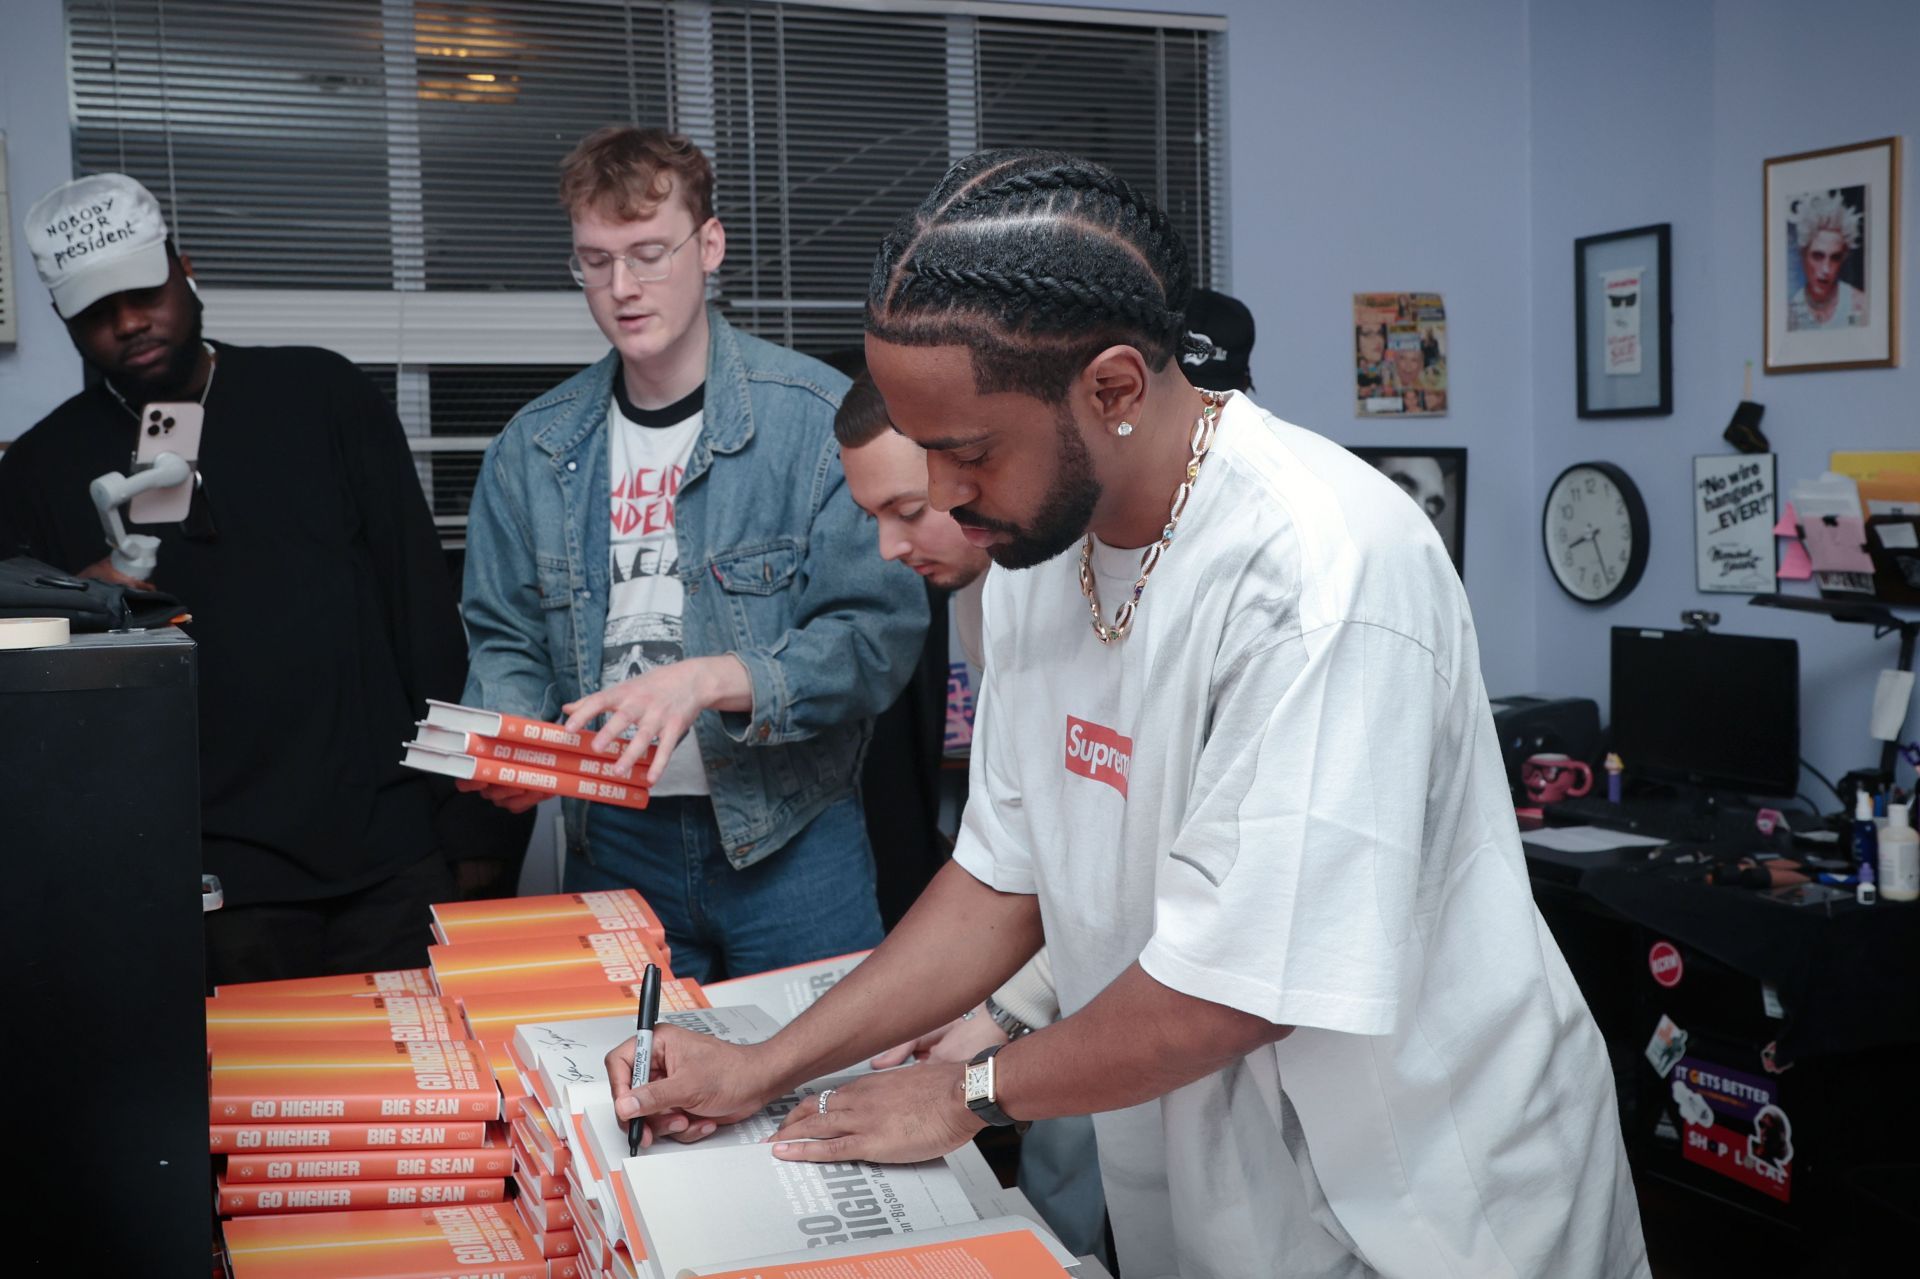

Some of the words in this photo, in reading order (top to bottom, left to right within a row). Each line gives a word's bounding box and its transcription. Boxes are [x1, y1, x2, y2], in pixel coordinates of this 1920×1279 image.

[46, 197, 113, 237] NOBODY
[66, 216, 110, 242] FOR
[54, 220, 136, 270] president
[1728, 463, 1760, 484] wire
[1703, 480, 1764, 513] hangers
[524, 724, 540, 739] GO
[541, 728, 581, 747] HIGHER
[605, 741, 619, 755] IG
[1067, 724, 1130, 781] Suprem
[494, 744, 511, 759] GO
[513, 748, 557, 767] HIGHER
[580, 759, 600, 774] BIG
[602, 763, 632, 780] SEN
[500, 768, 516, 782] GO
[517, 770, 558, 789] HIGHER
[578, 781, 597, 795] BIG
[598, 784, 627, 800] SEAN
[390, 1026, 424, 1041] GO
[631, 1052, 645, 1086] Sharpie
[415, 1074, 453, 1090] GO
[1675, 1065, 1688, 1080] IT
[1721, 1078, 1770, 1104] BETTER
[252, 1100, 276, 1117] GO
[281, 1099, 344, 1117] HIGHER
[381, 1098, 411, 1115] BIG
[415, 1098, 459, 1115] SEAN
[236, 1130, 261, 1147] GO
[266, 1128, 330, 1146] HIGHER
[367, 1127, 397, 1144] BIG
[401, 1127, 445, 1144] SEAN
[267, 1160, 292, 1178] GO
[297, 1160, 360, 1177] HIGHER
[396, 1158, 426, 1175] BIG
[430, 1157, 474, 1174] SEAN
[258, 1190, 282, 1208] GO
[287, 1189, 351, 1207] HIGHER
[388, 1187, 417, 1204] BIG
[421, 1185, 465, 1203] SEAN
[433, 1208, 487, 1246] HIGHER
[452, 1246, 496, 1264] GO
